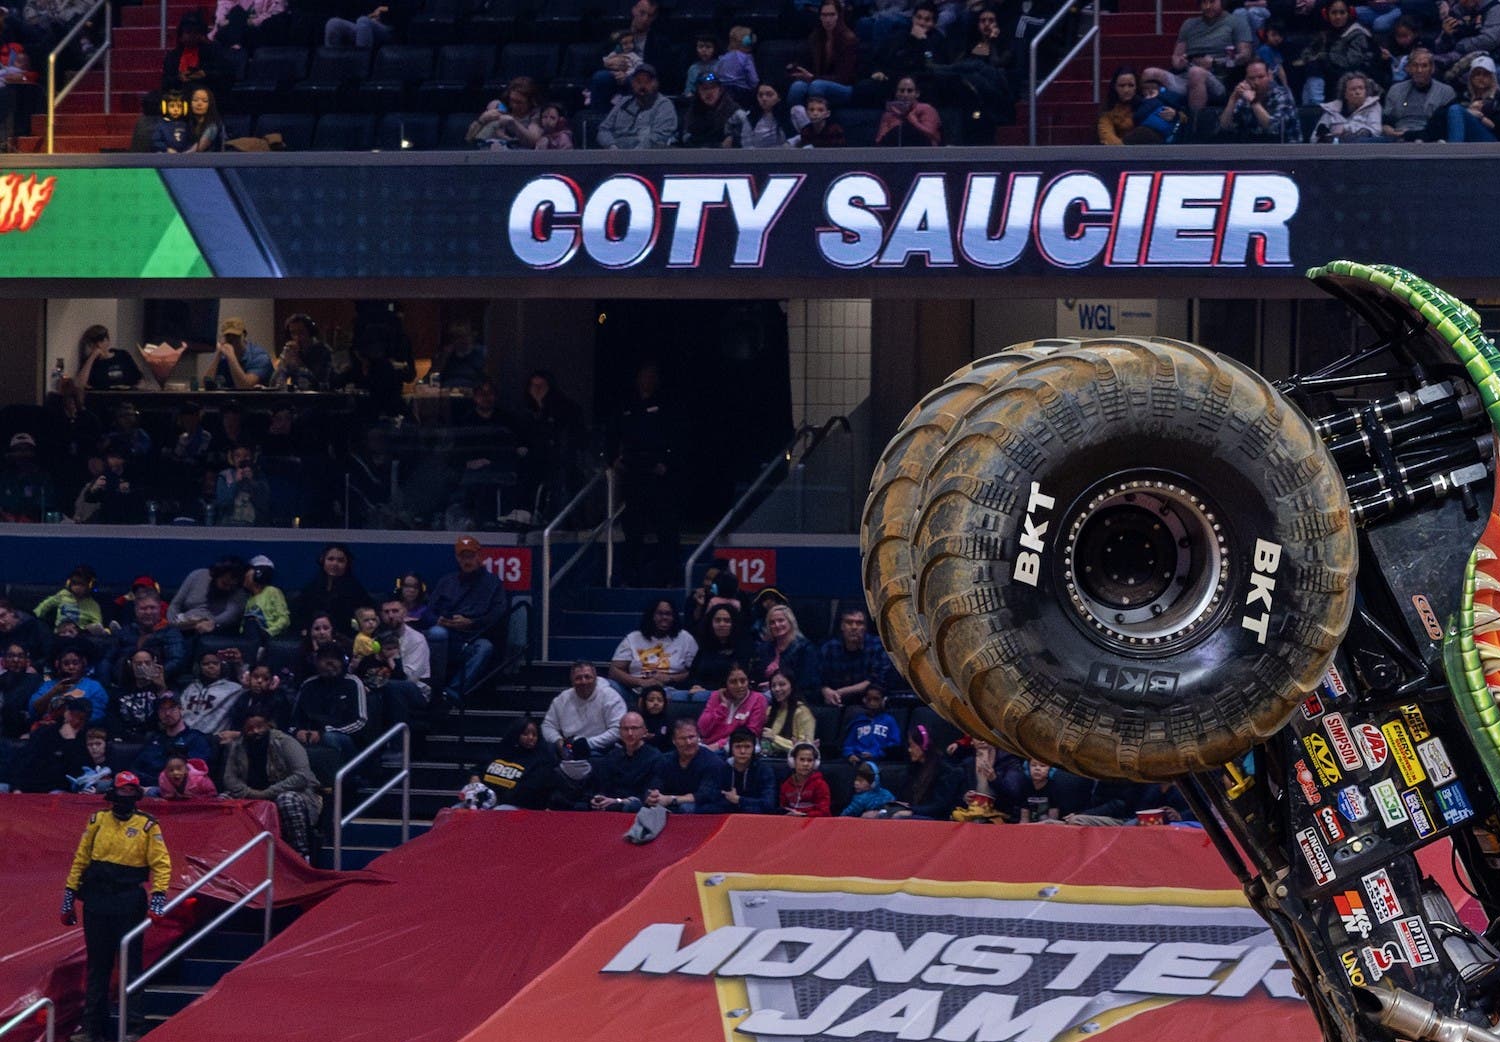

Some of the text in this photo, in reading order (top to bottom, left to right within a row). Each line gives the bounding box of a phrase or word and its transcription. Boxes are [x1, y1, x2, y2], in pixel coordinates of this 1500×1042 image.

[508, 170, 1300, 269] COTY SAUCIER
[1078, 303, 1115, 331] WGL
[1013, 481, 1055, 587] BKT
[483, 557, 521, 582] 113
[1241, 537, 1282, 645] BKT
[1327, 717, 1356, 765] SIMPSON
[1362, 723, 1389, 762] JAZ
[1394, 724, 1413, 761] ENERGY
[1378, 783, 1403, 820] BKT
[1321, 807, 1341, 838] Coan
[1303, 843, 1322, 879] WELDERS
[1306, 831, 1328, 871] LINCOLN
[1364, 879, 1384, 918] ENDS
[1373, 887, 1389, 916] ROD
[1408, 919, 1432, 959] OPTIMA
[600, 922, 1303, 999] MONSTER
